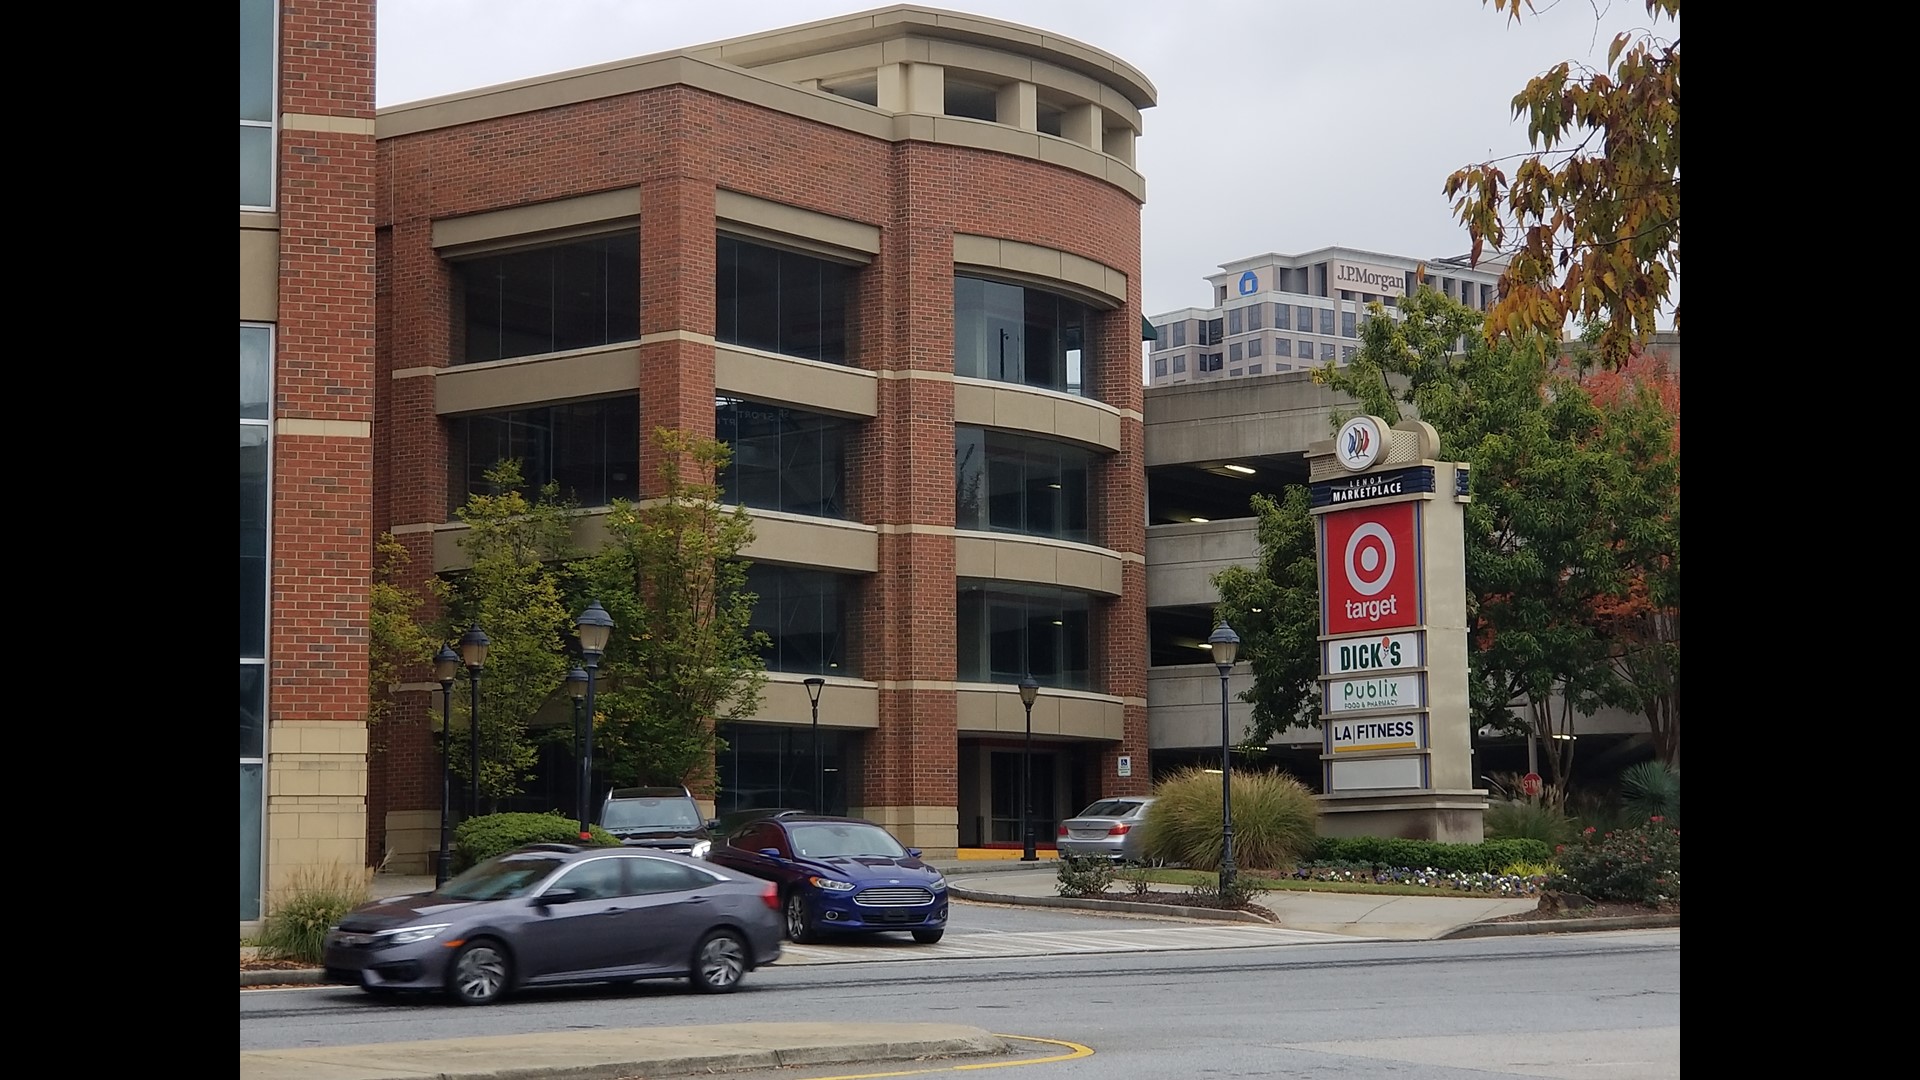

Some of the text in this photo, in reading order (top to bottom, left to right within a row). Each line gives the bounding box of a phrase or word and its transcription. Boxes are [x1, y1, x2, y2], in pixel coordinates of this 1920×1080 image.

[1337, 264, 1405, 292] J.P.Morgan
[1332, 482, 1402, 502] MARKETPLACE
[1349, 476, 1382, 488] LENOX
[1345, 594, 1397, 621] target
[1340, 637, 1402, 671] DICK'S
[1344, 678, 1398, 701] Publix
[1344, 701, 1361, 710] FOOD
[1367, 699, 1398, 708] PHARMACY
